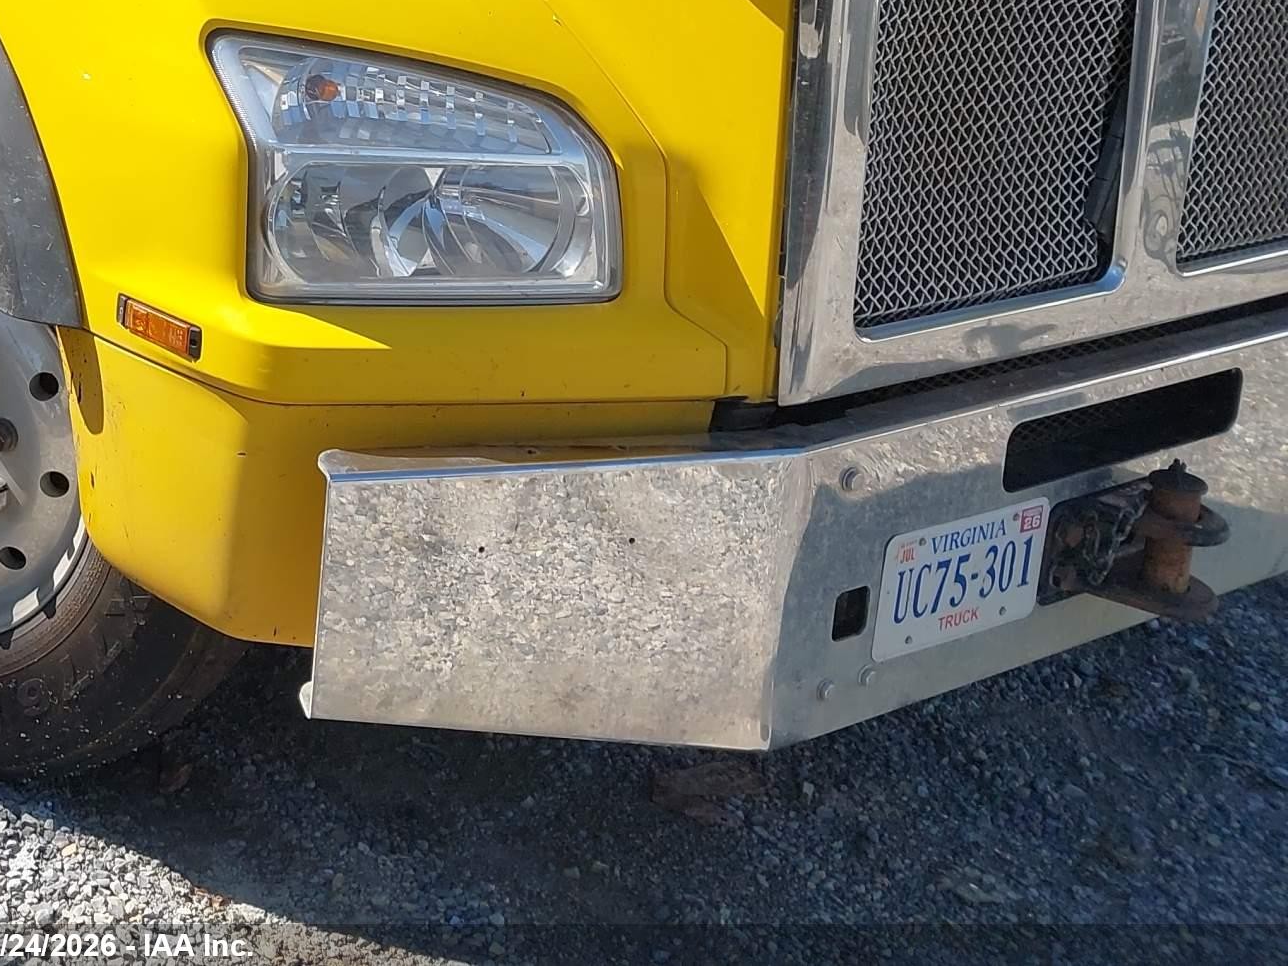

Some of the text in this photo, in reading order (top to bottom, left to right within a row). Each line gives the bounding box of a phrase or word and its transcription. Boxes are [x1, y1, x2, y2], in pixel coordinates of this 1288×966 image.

[1023, 514, 1041, 531] 26
[931, 519, 1006, 555] VIRGINIA
[899, 546, 915, 564] JUL
[893, 535, 1034, 624] UC75-301
[937, 607, 979, 631] TRUCK
